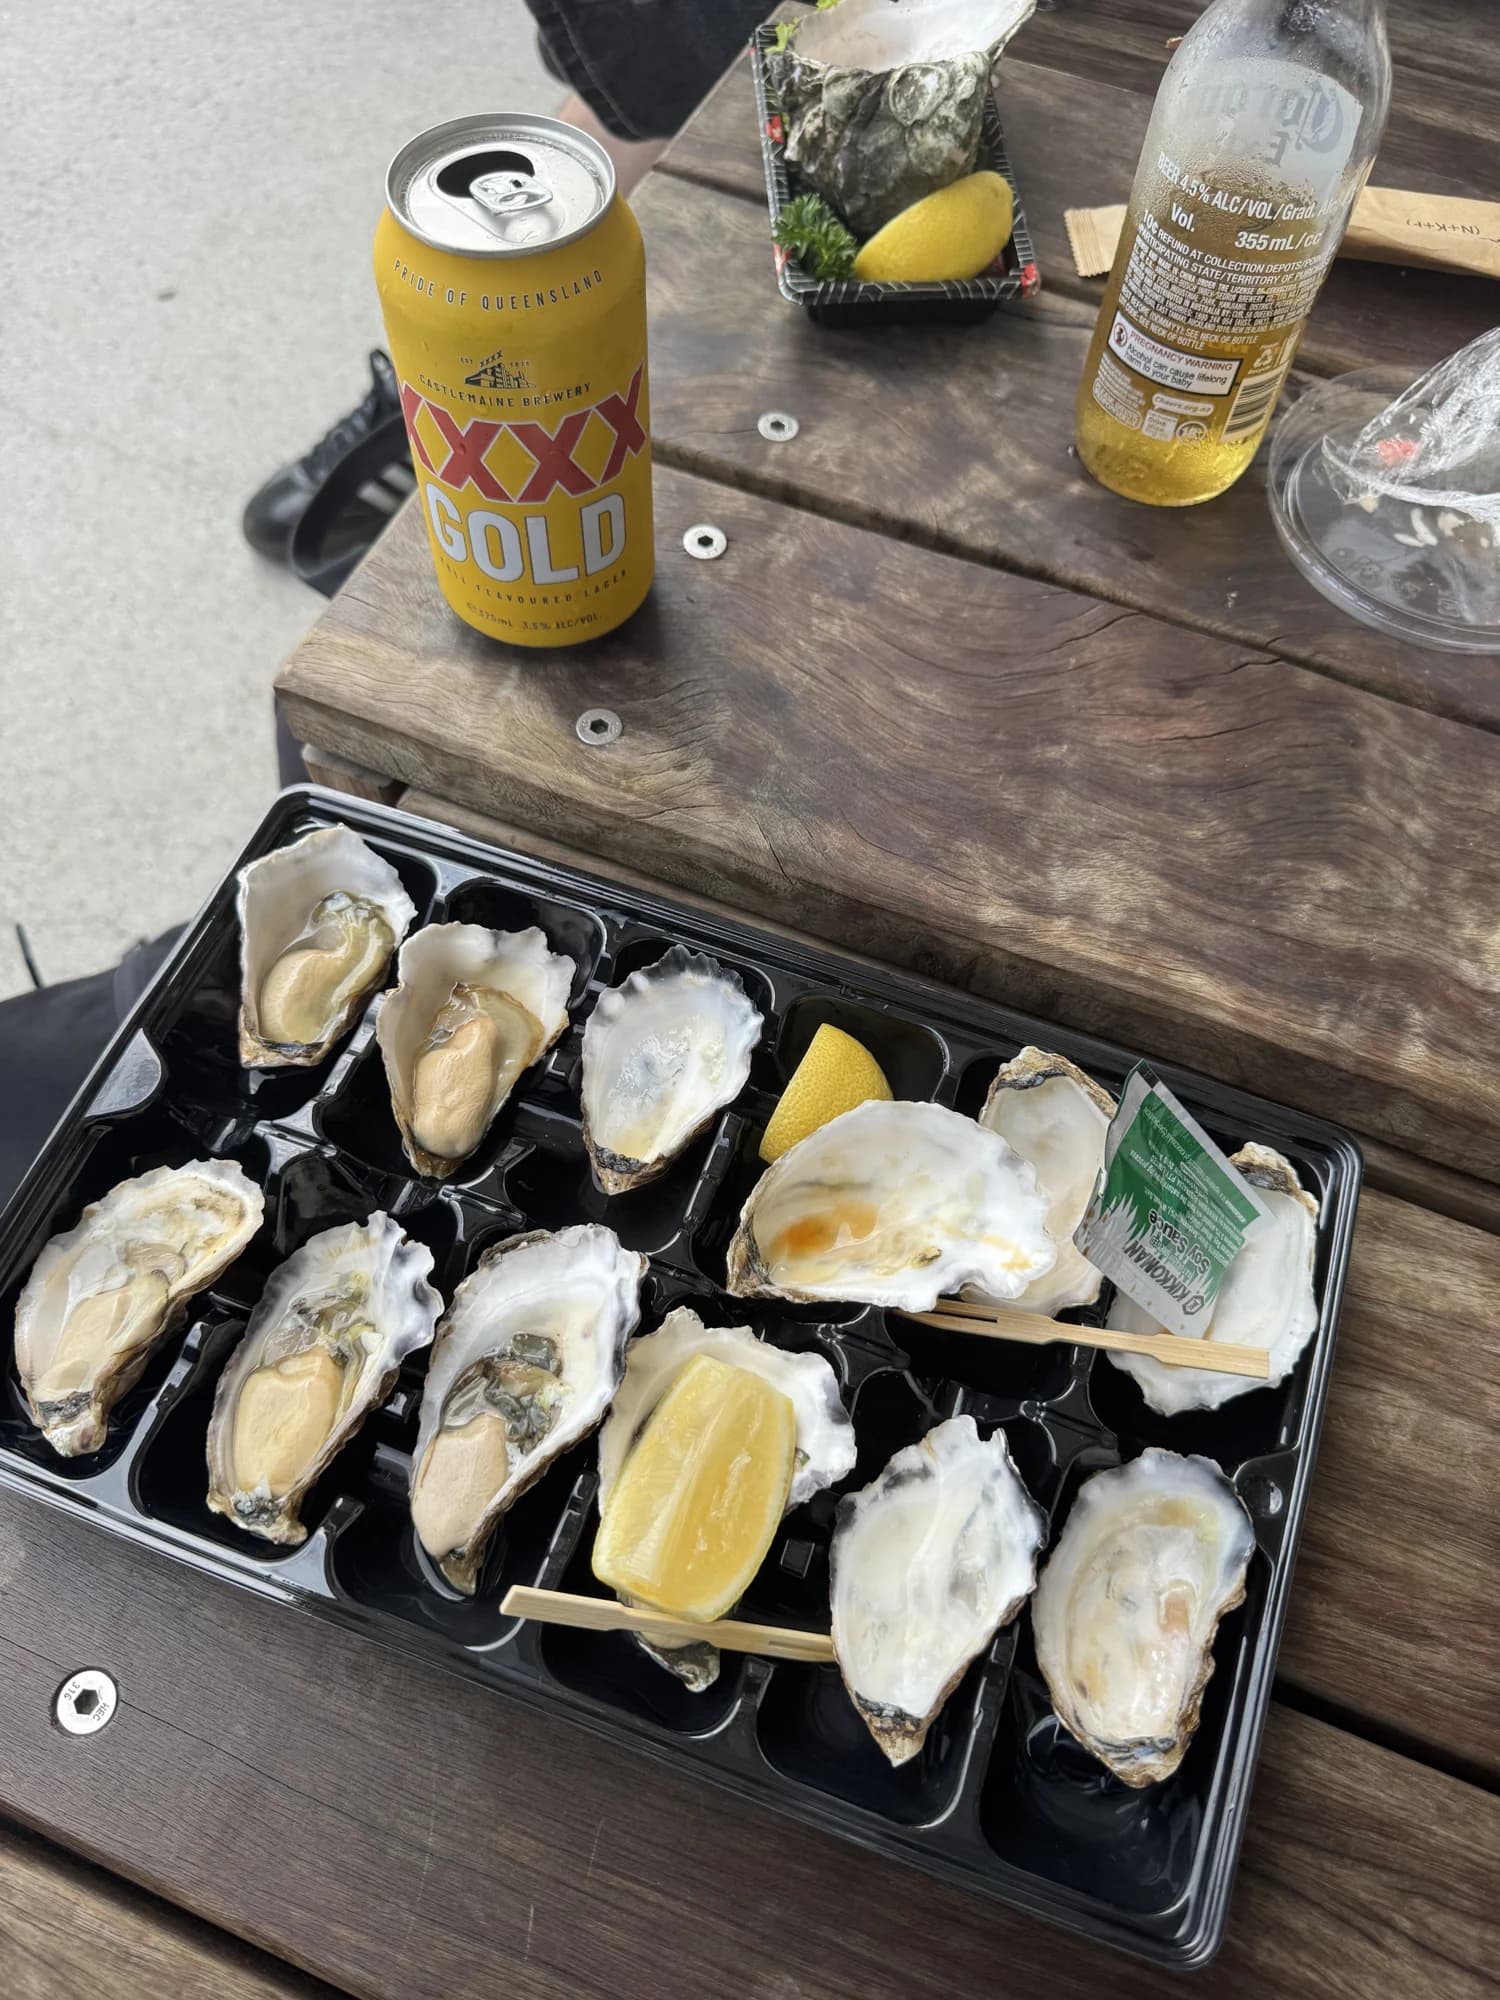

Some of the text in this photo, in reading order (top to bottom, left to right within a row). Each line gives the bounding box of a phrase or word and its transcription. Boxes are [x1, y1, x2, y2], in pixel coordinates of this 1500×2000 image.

[1158, 152, 1180, 185] BEER
[1179, 175, 1211, 203] 4.5%
[1171, 202, 1195, 232] Vol.
[1138, 224, 1190, 269] PARTICIPATING
[1191, 262, 1280, 285] STATE/TERRITORY
[1282, 273, 1296, 283] OF
[1158, 228, 1190, 255] REFUND
[1189, 249, 1203, 261] AT
[1204, 254, 1265, 273] COLLECTION
[394, 257, 602, 311] PRIDE OF QUEENSLAND
[1130, 329, 1184, 363] PREGNANCY
[1185, 357, 1233, 371] WARNING
[1177, 335, 1205, 351] BOTTLE
[1185, 328, 1200, 339] SEE
[1231, 335, 1259, 344] BOTTLE
[1124, 350, 1193, 389] harm to your baby
[1127, 343, 1228, 386] Alcohol can cause lifelong
[418, 374, 592, 407] CASTLEMAINE BREWERY
[425, 482, 627, 586] GOLD
[476, 584, 573, 605] FLAVOURED
[584, 569, 627, 597] LAGER
[1148, 1209, 1188, 1254] Sauce
[1123, 1240, 1191, 1302] KIKKOMAN
[1188, 1244, 1210, 1275] Soy
[63, 1681, 80, 1701] 316
